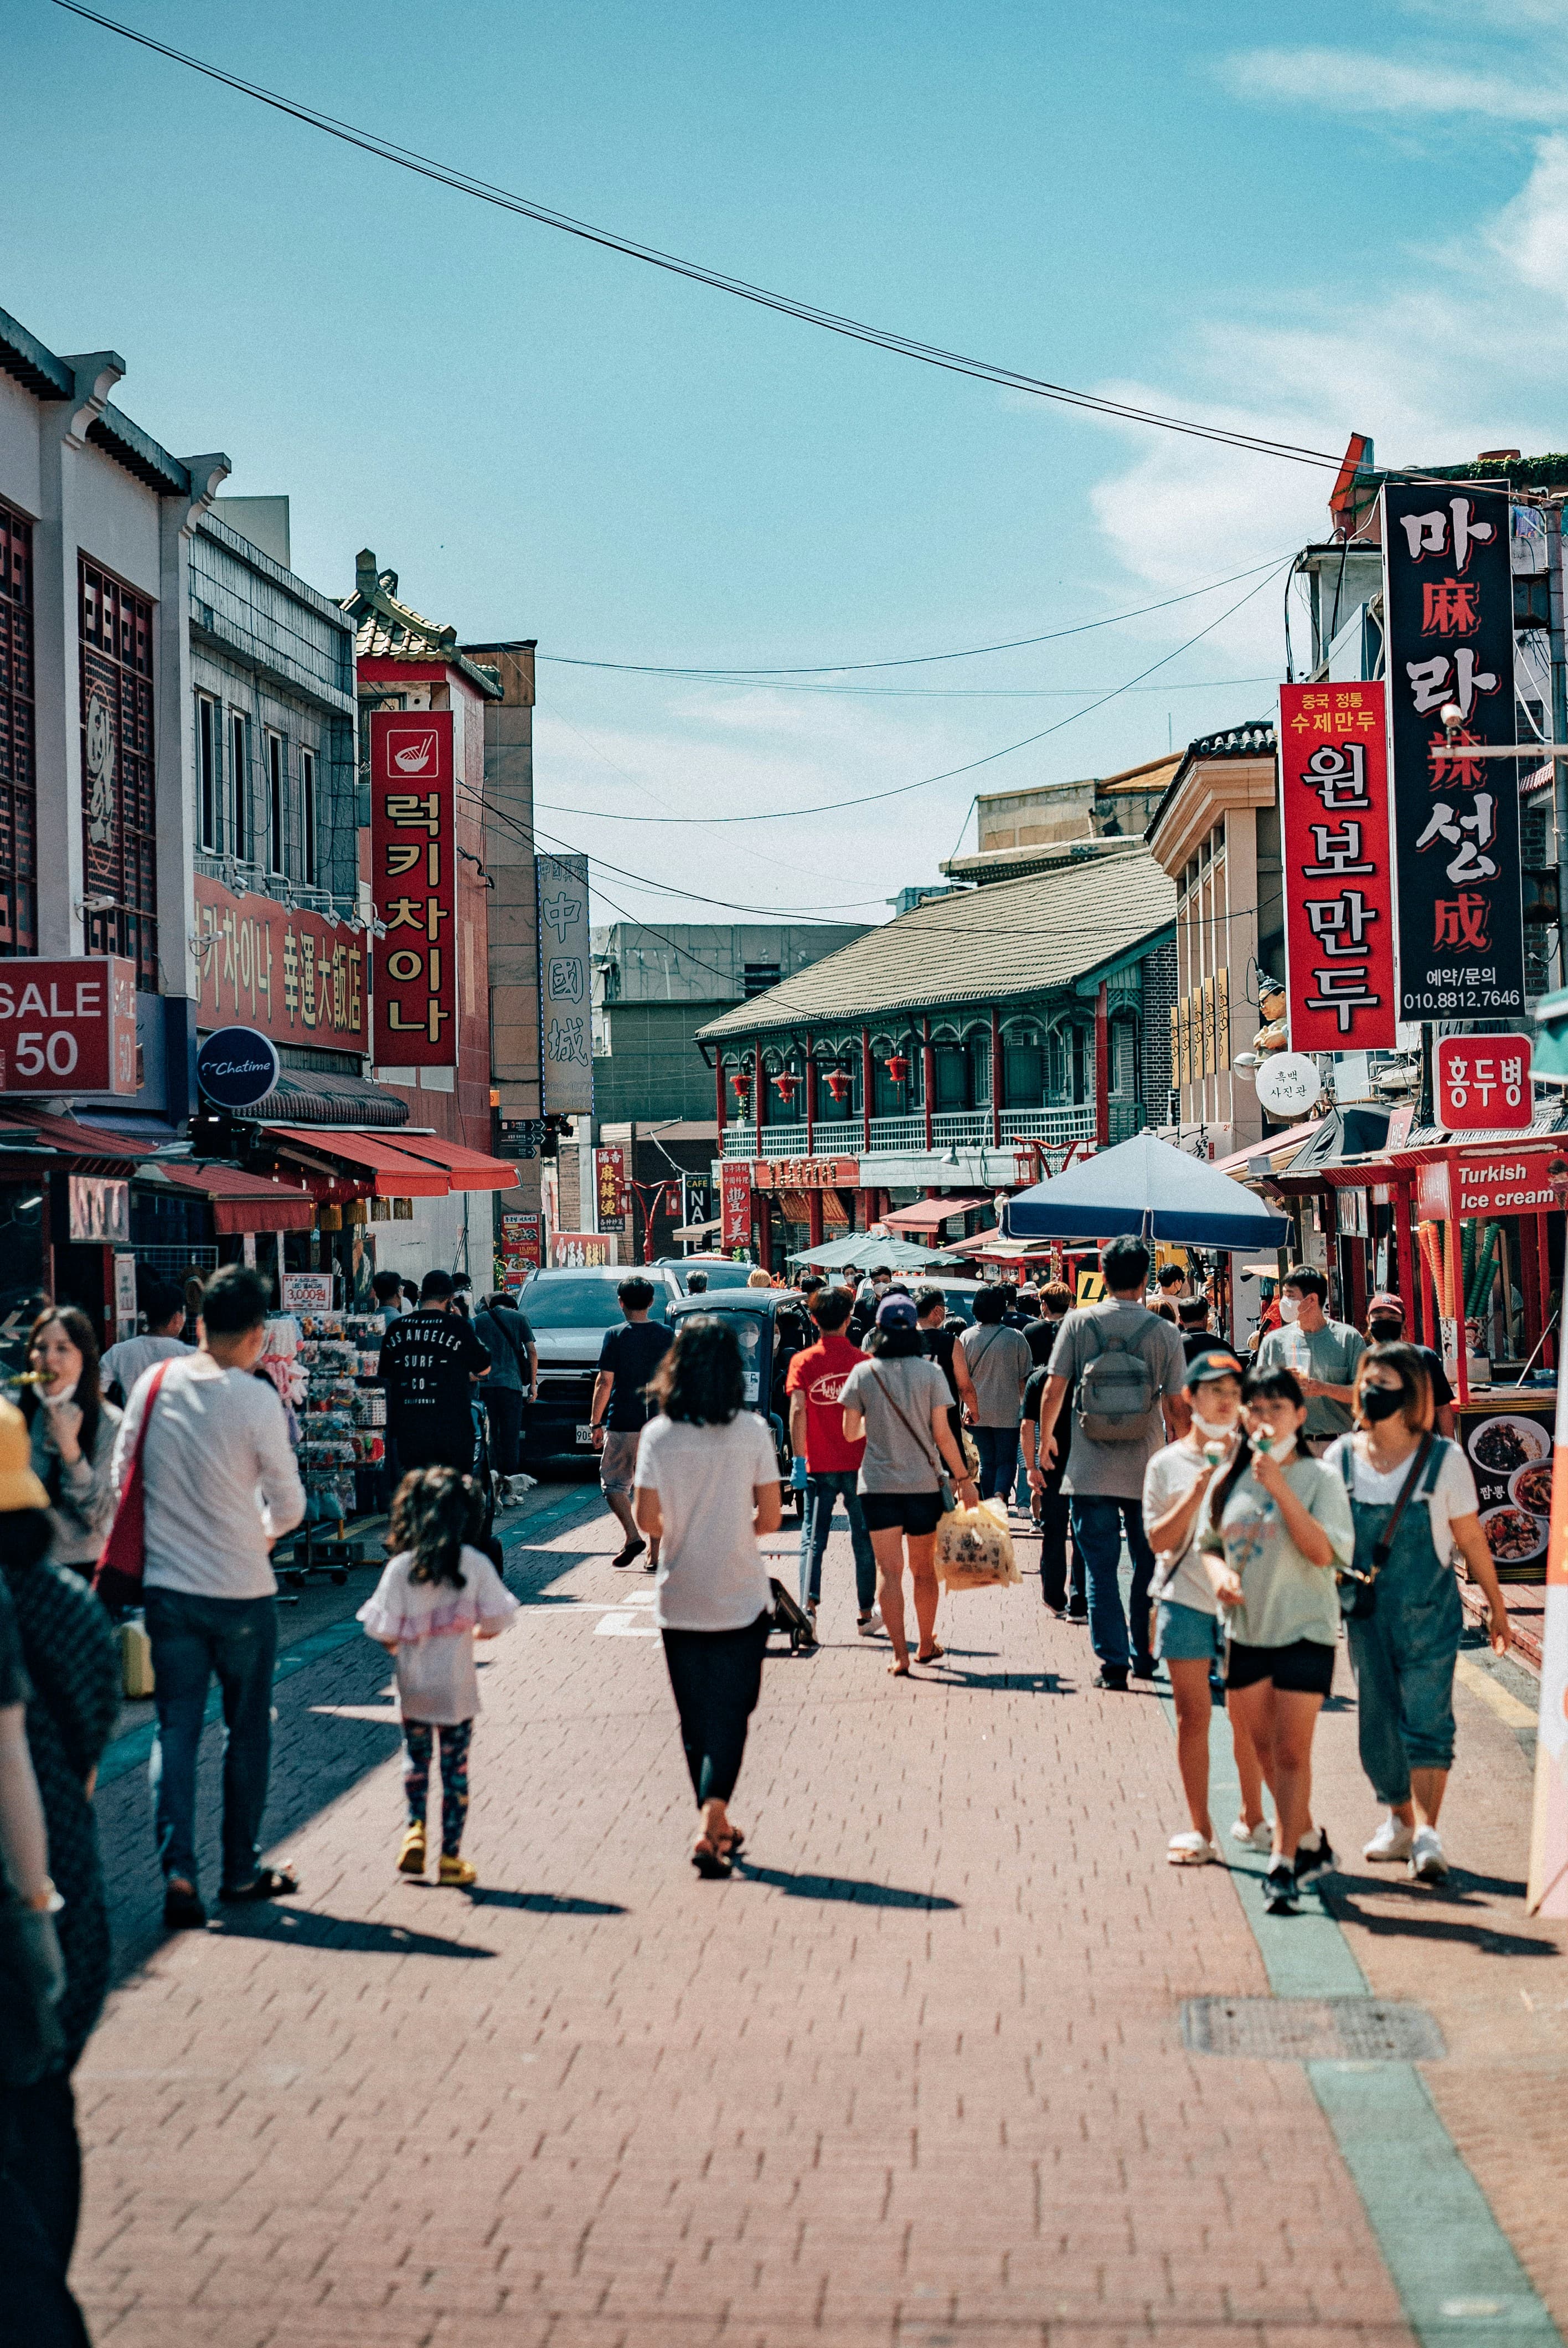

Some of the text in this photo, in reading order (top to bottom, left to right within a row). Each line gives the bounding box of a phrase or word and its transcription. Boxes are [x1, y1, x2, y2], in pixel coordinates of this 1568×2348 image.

[1302, 692, 1363, 709] 중국 정통
[1291, 711, 1376, 733] 수제만두
[1303, 744, 1380, 1032] 원보만두
[387, 794, 448, 1044] 럭키차이나
[283, 924, 360, 1034] 幸運大飯店
[543, 892, 589, 1067] 中國城
[1426, 967, 1496, 987] 예약/문의
[0, 982, 101, 1019] SALE
[1404, 990, 1520, 1010] 010.8812.7646
[16, 1031, 78, 1076] 50
[216, 1060, 270, 1075] Chatime
[1275, 1070, 1298, 1082] 흑백
[1270, 1085, 1307, 1098] 사진관
[1447, 1055, 1523, 1109] 홍두병
[686, 1180, 708, 1188] CAFE
[1458, 1163, 1527, 1185] Turkish
[1461, 1189, 1554, 1209] Ice cream
[287, 1289, 326, 1301] 3,000원
[406, 1329, 461, 1351] ANGELES
[405, 1355, 434, 1367] SURF
[412, 1378, 425, 1390] CO
[1479, 1485, 1505, 1500] 짬뽕
